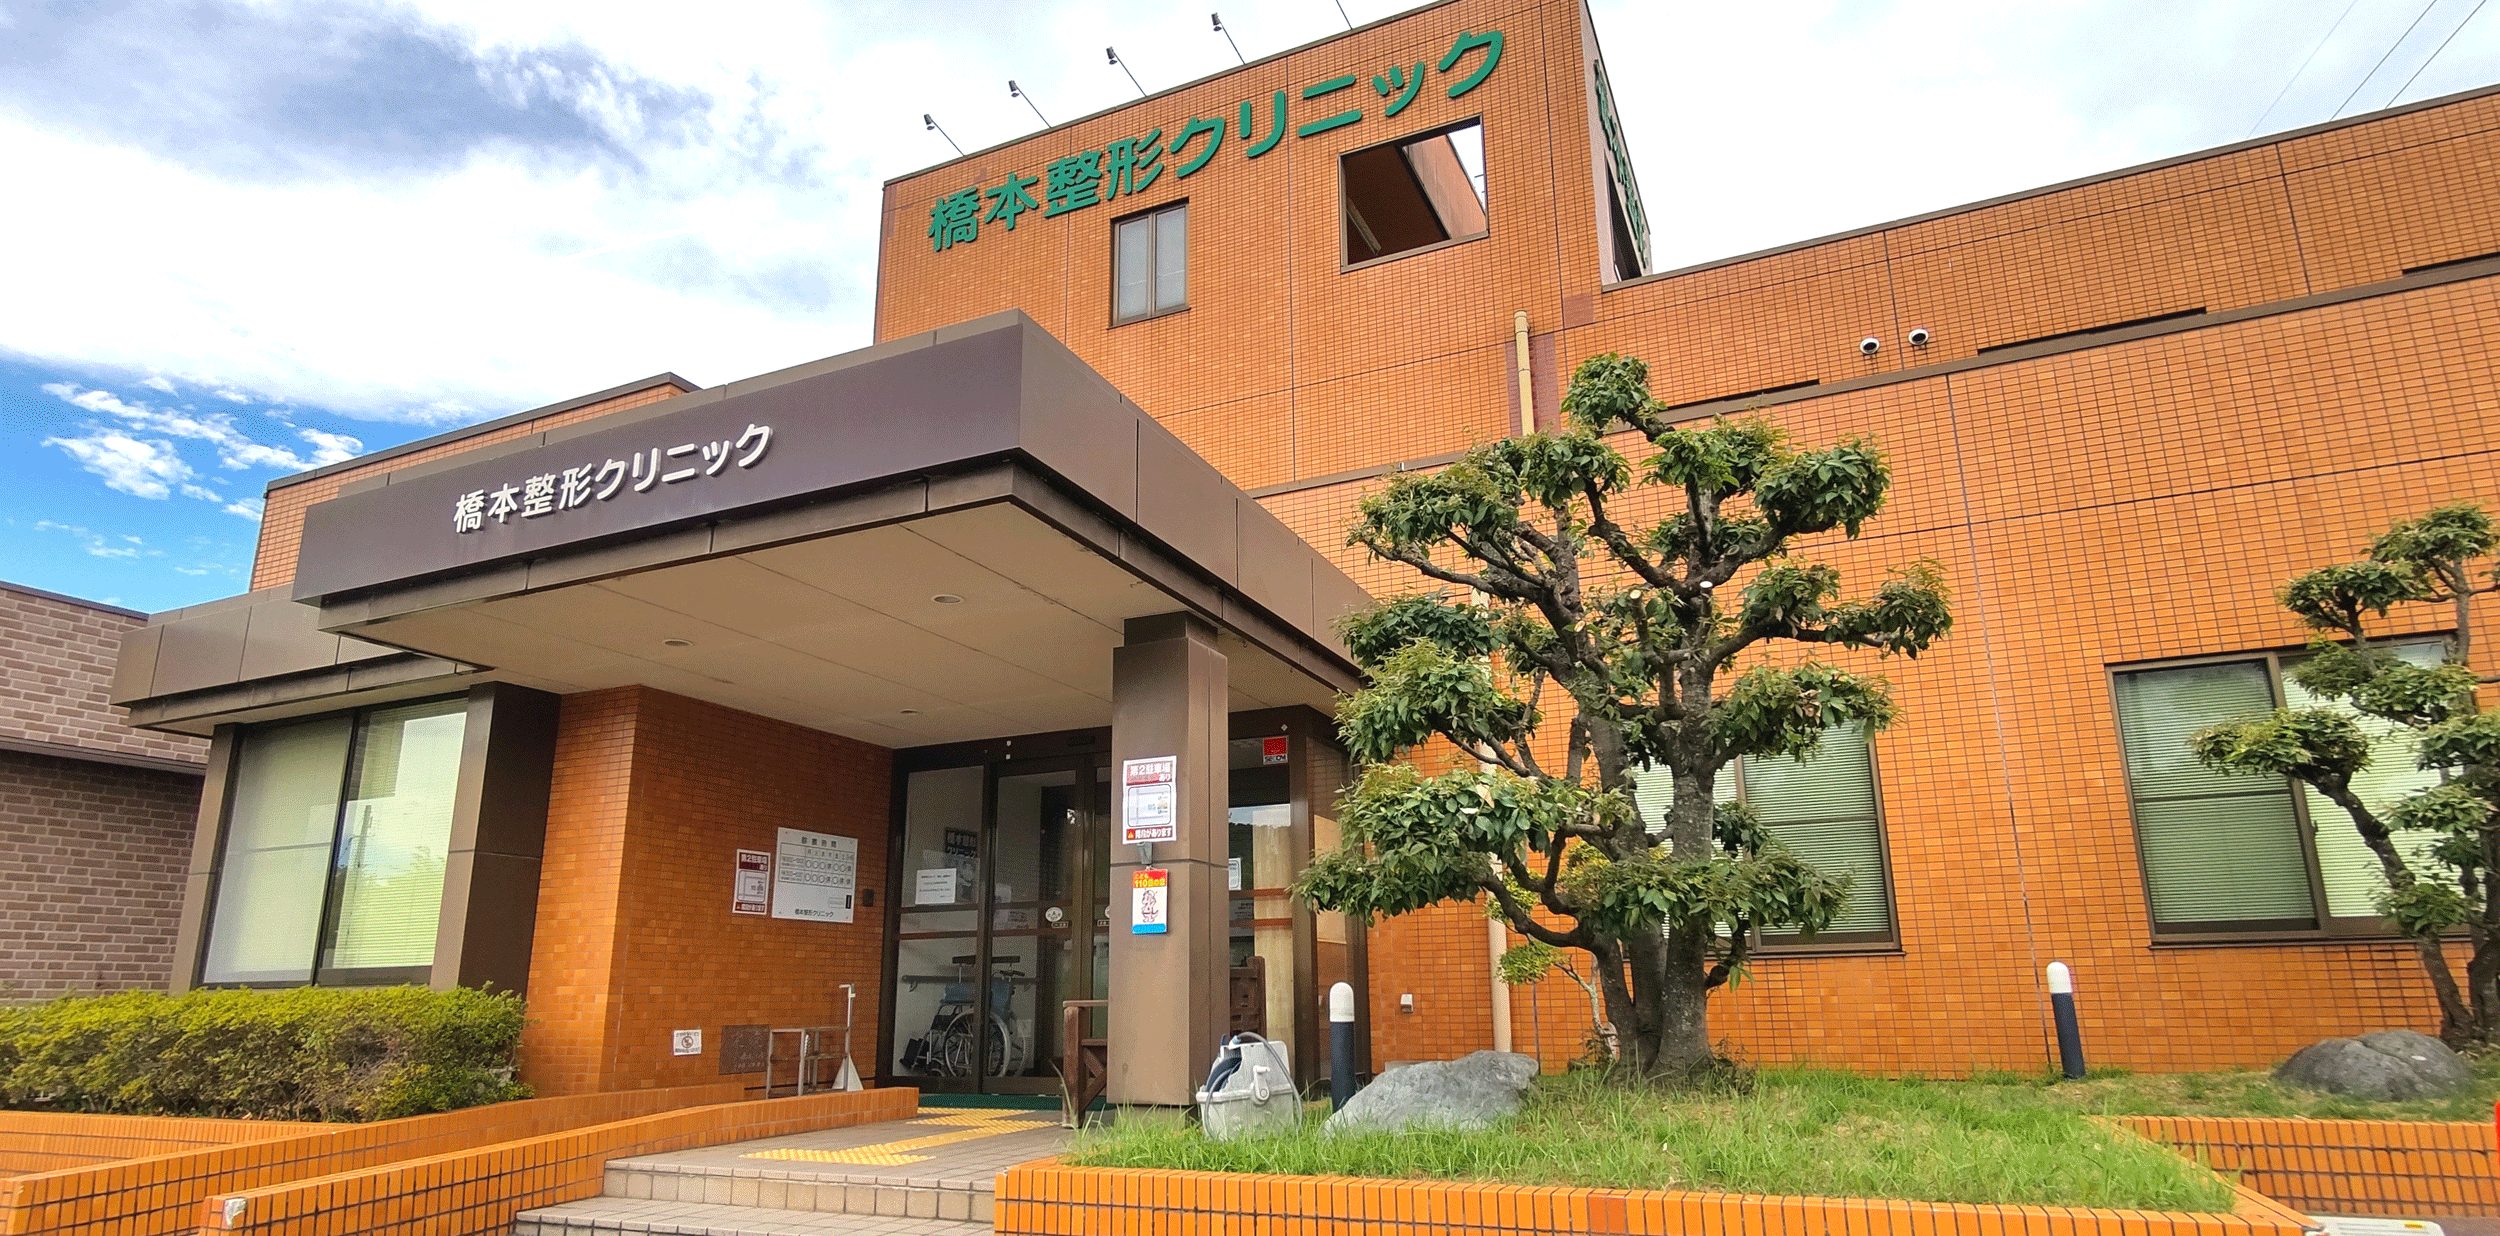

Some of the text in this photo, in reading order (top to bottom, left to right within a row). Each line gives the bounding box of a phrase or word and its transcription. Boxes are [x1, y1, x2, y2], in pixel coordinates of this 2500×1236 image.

[926, 28, 1505, 254] 橋本整形クリニック
[454, 423, 773, 533] 橋本整形クリニック
[1130, 761, 1171, 777] 第2駐車場
[1159, 773, 1171, 782] あり
